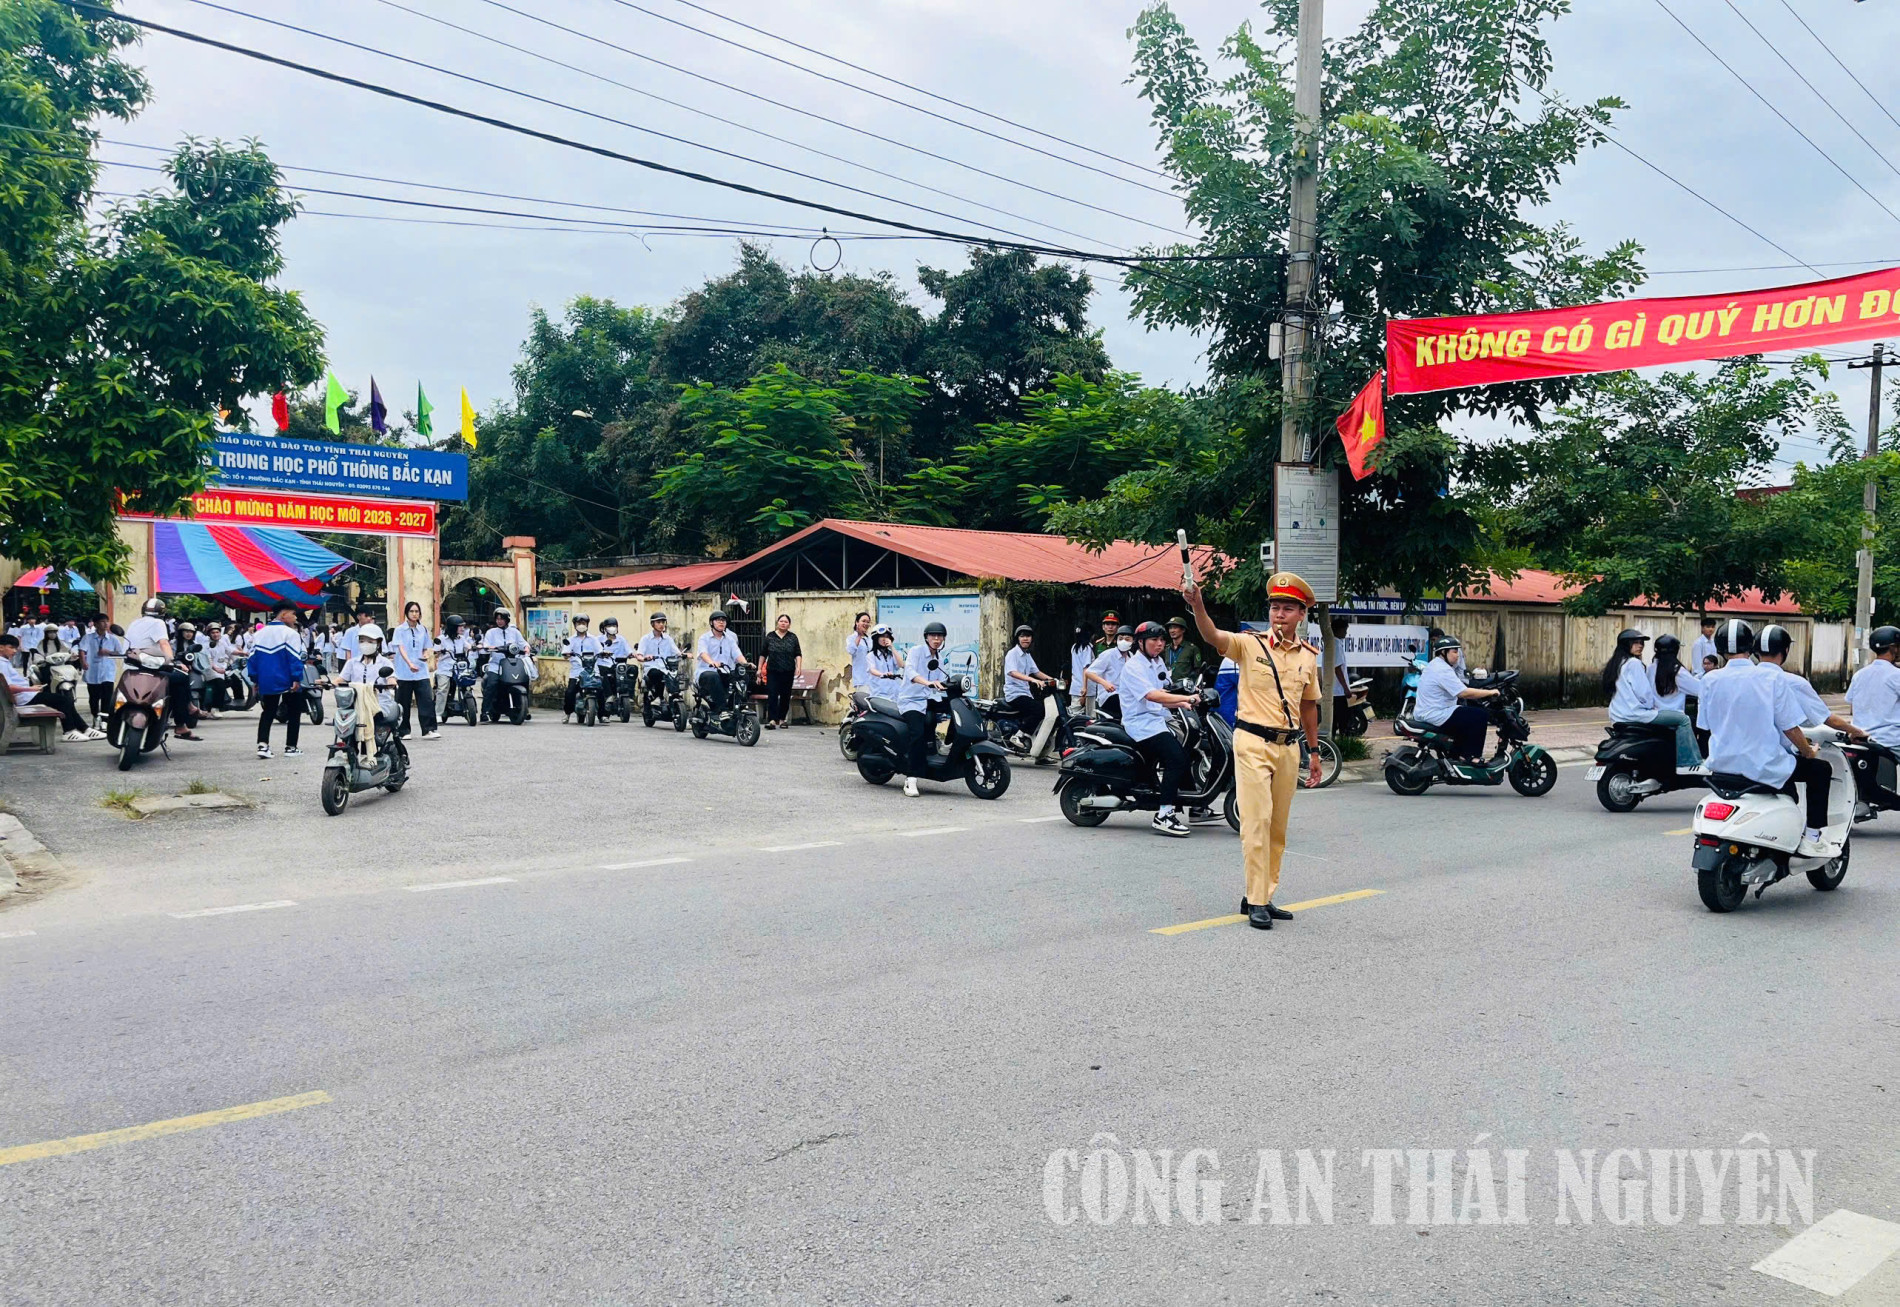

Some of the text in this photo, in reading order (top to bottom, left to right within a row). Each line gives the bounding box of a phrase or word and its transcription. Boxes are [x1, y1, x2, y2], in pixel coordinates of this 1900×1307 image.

[1416, 327, 1531, 368] KHÔNG
[1541, 318, 1594, 354] CÓ
[1604, 312, 1647, 350] GÌ
[1657, 302, 1742, 346] QUÝ
[1751, 294, 1847, 333] HƠN
[242, 438, 262, 448] DỤC
[265, 440, 278, 449] VÀ
[281, 441, 300, 450] ĐÀO
[302, 444, 321, 452] TẠO
[348, 448, 371, 457] THÁI
[373, 450, 409, 460] NGUYÊN
[218, 451, 269, 471] TRUNG
[273, 456, 303, 476] HỌC
[308, 454, 338, 476] PHỔ
[341, 459, 388, 481] THÔNG
[392, 461, 421, 483] BẮC
[424, 468, 452, 487] KẠN
[196, 496, 231, 515] CHÀO
[235, 498, 274, 517] MỪNG
[277, 501, 306, 520] NĂM
[310, 505, 334, 524] HỌC
[337, 505, 361, 523] MỚI
[364, 509, 392, 525] 2026
[395, 512, 427, 527] -2027
